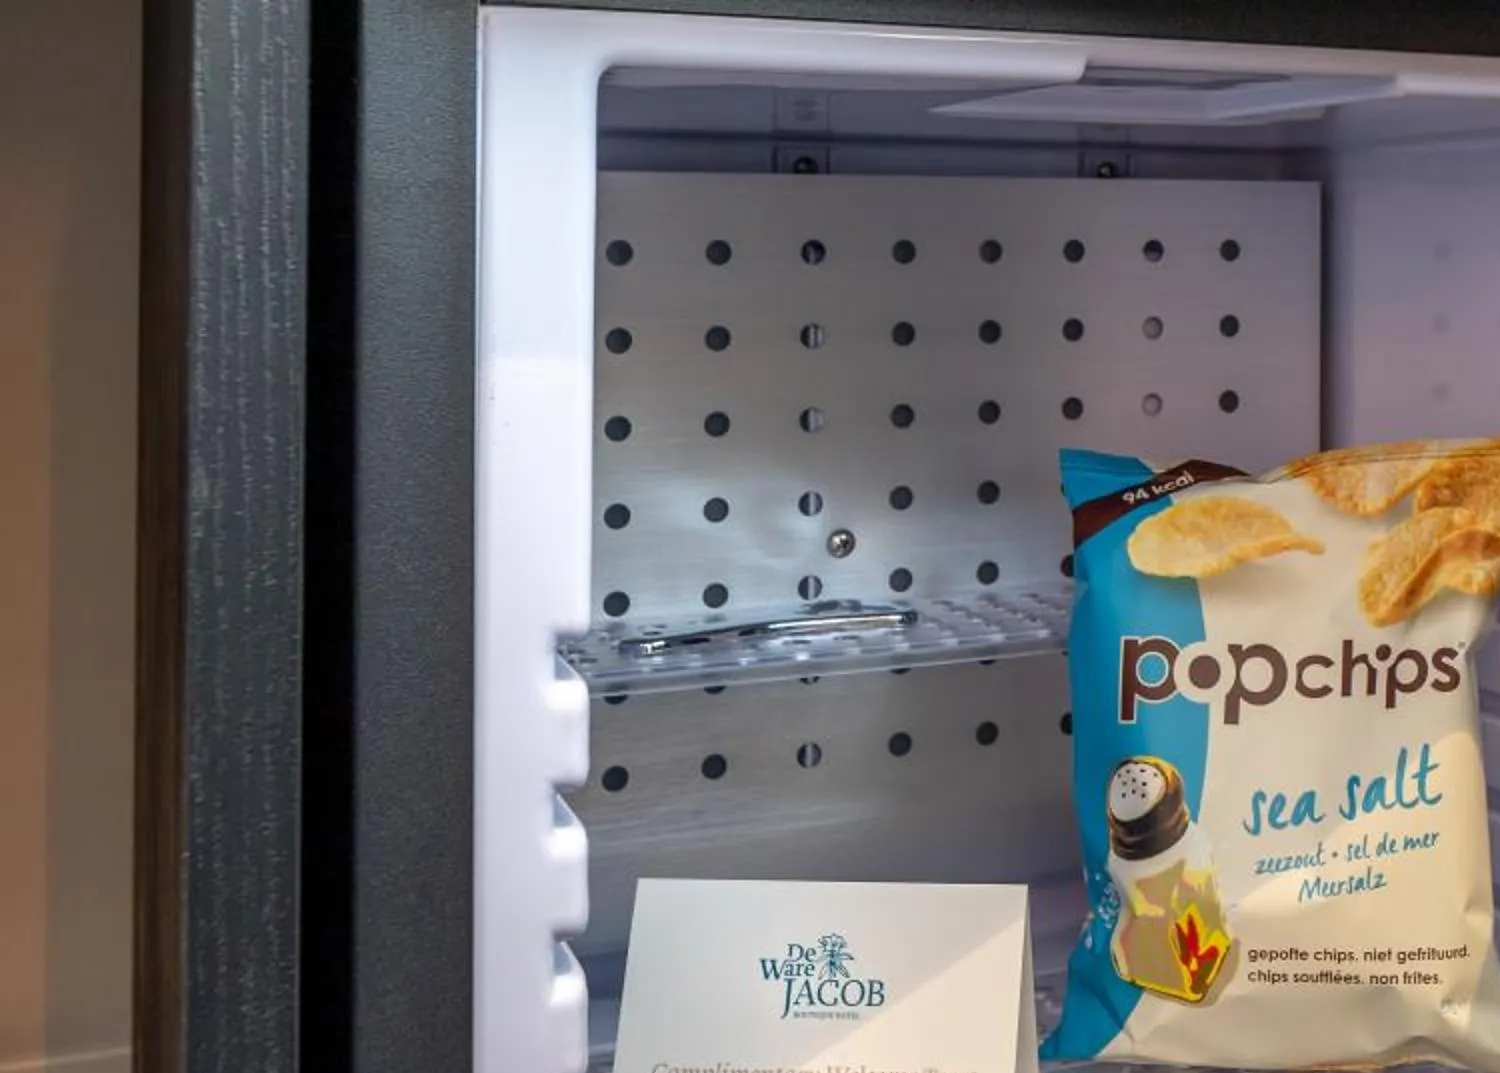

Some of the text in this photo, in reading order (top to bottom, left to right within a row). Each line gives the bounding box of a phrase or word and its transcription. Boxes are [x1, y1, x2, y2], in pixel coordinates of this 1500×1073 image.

[1122, 470, 1195, 505] 94 kcal
[1118, 634, 1461, 725] popchips
[1242, 743, 1443, 836] sea salt
[1254, 831, 1440, 876] zeezout sel de mer
[1298, 870, 1388, 902] Meersalz
[787, 943, 816, 962] De
[1247, 946, 1311, 966] gepofte
[1363, 947, 1393, 962] niet
[760, 958, 816, 981] Ware
[1247, 967, 1290, 987] chips
[1369, 972, 1400, 985] non
[780, 978, 886, 1019] JACOB
